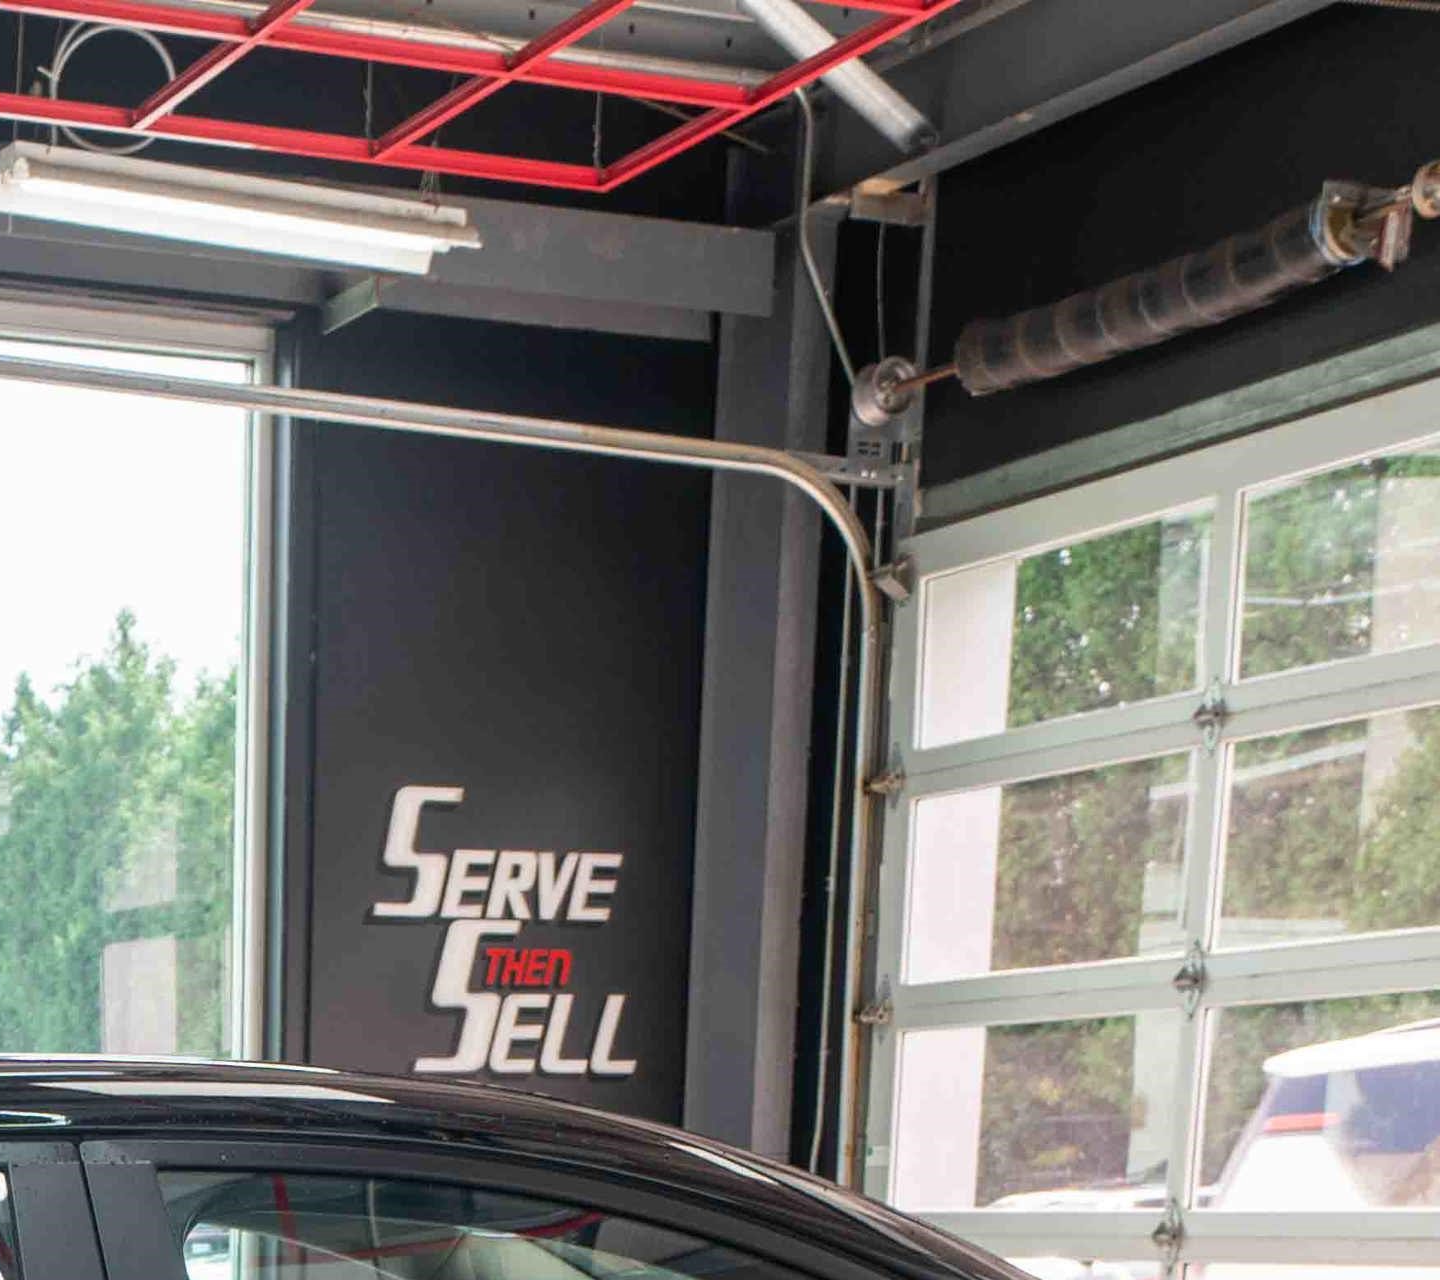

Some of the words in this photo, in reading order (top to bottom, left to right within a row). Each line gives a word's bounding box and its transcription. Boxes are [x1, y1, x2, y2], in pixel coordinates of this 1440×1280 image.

[373, 785, 623, 921] SERVE
[414, 919, 637, 1075] SELL
[486, 948, 572, 986] THEN
